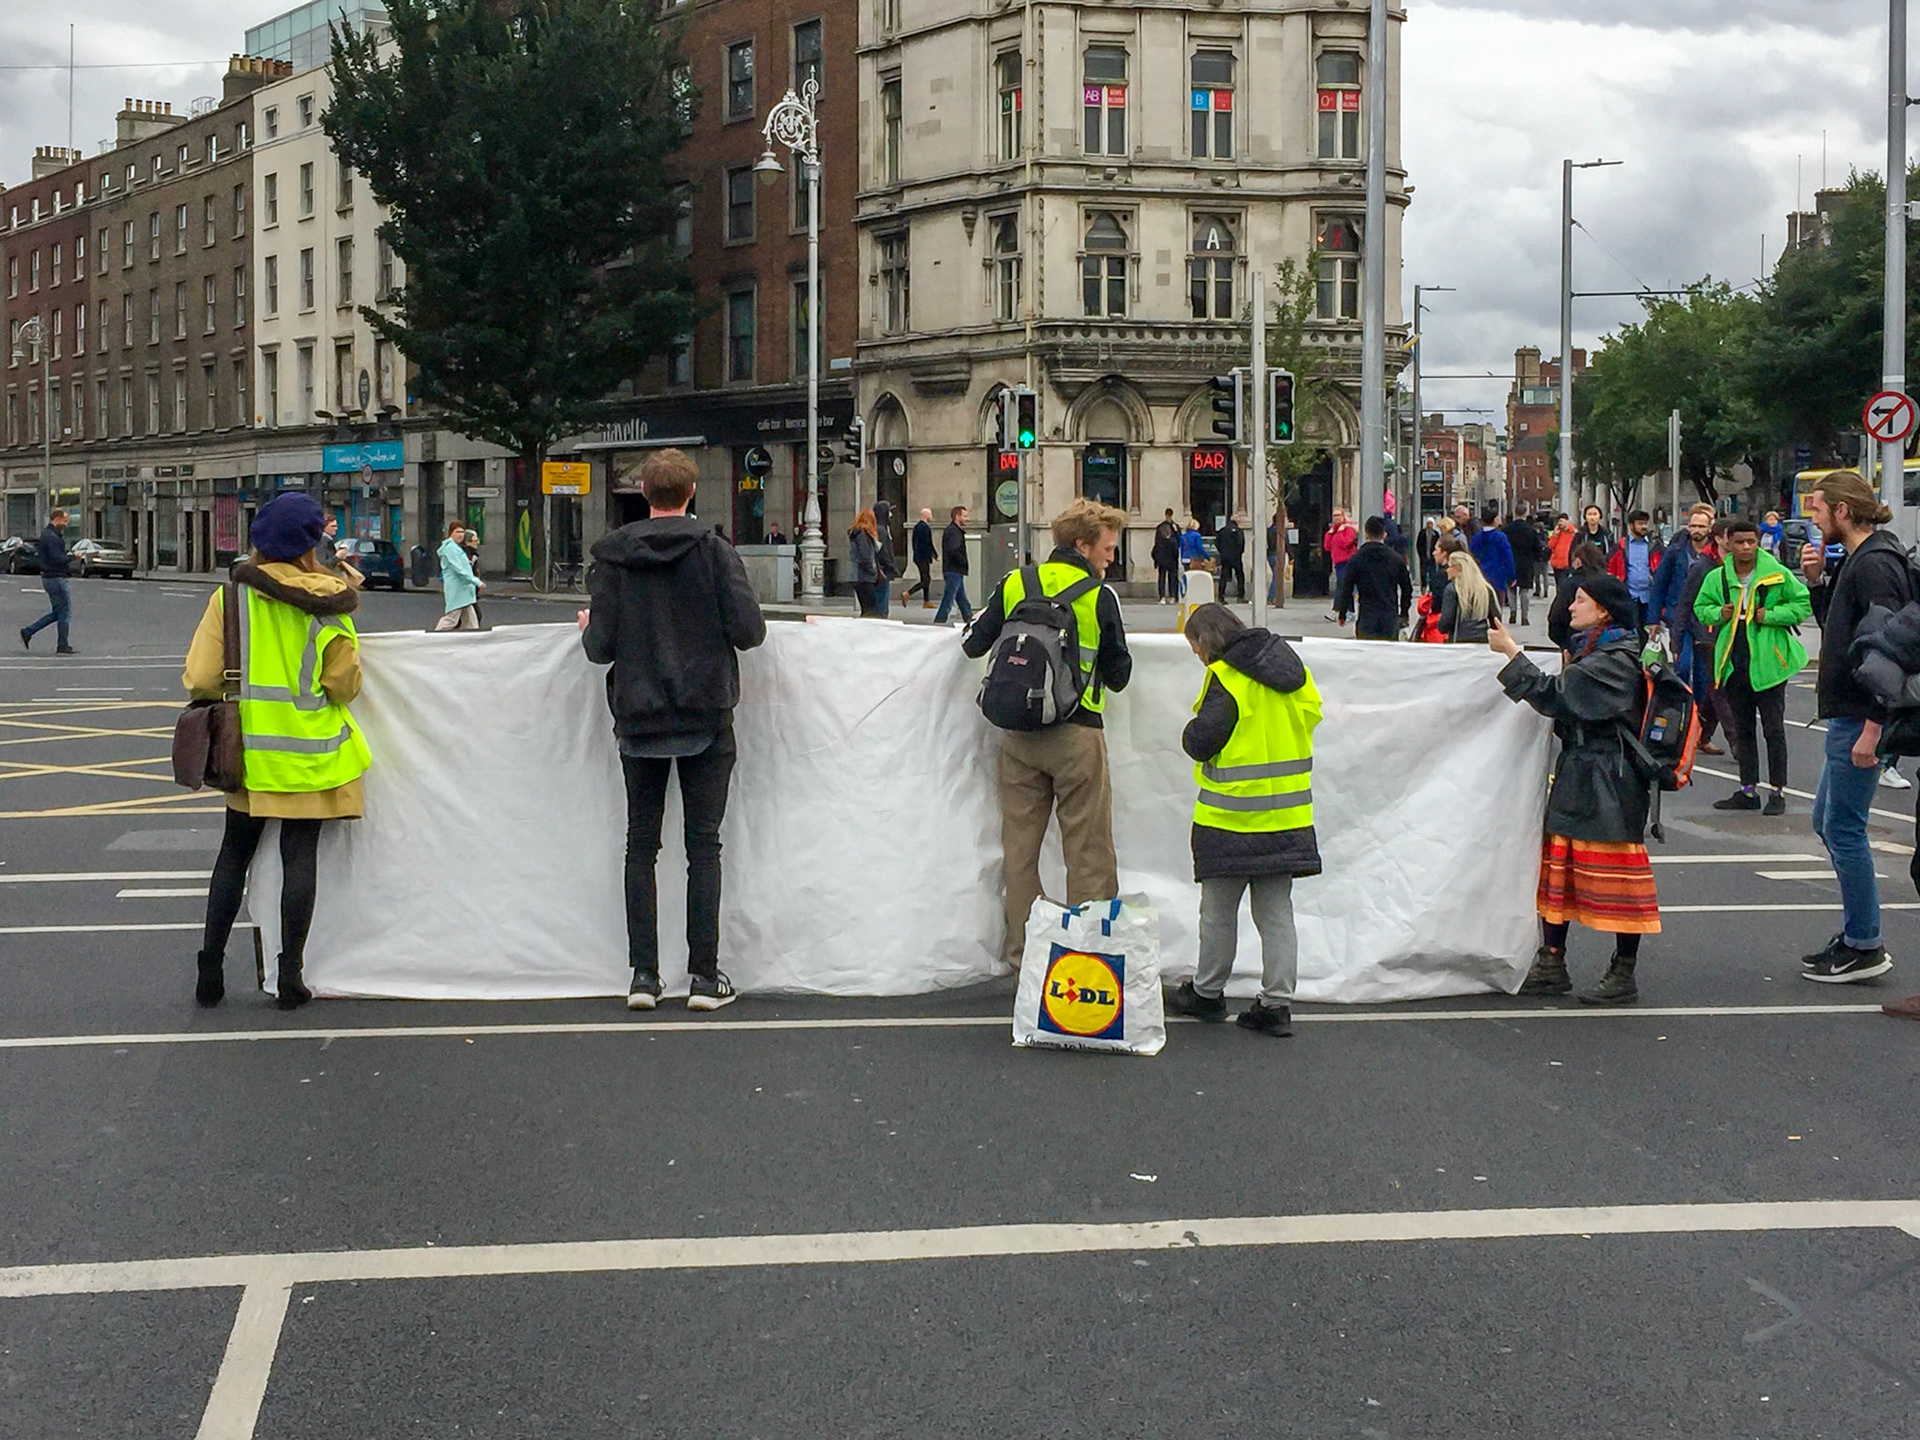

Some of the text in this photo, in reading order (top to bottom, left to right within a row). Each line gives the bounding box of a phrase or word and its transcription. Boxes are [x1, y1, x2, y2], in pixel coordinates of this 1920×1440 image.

[1084, 89, 1101, 102] AB
[1195, 94, 1205, 106] B
[1206, 227, 1220, 250] A
[1194, 452, 1225, 470] BAR
